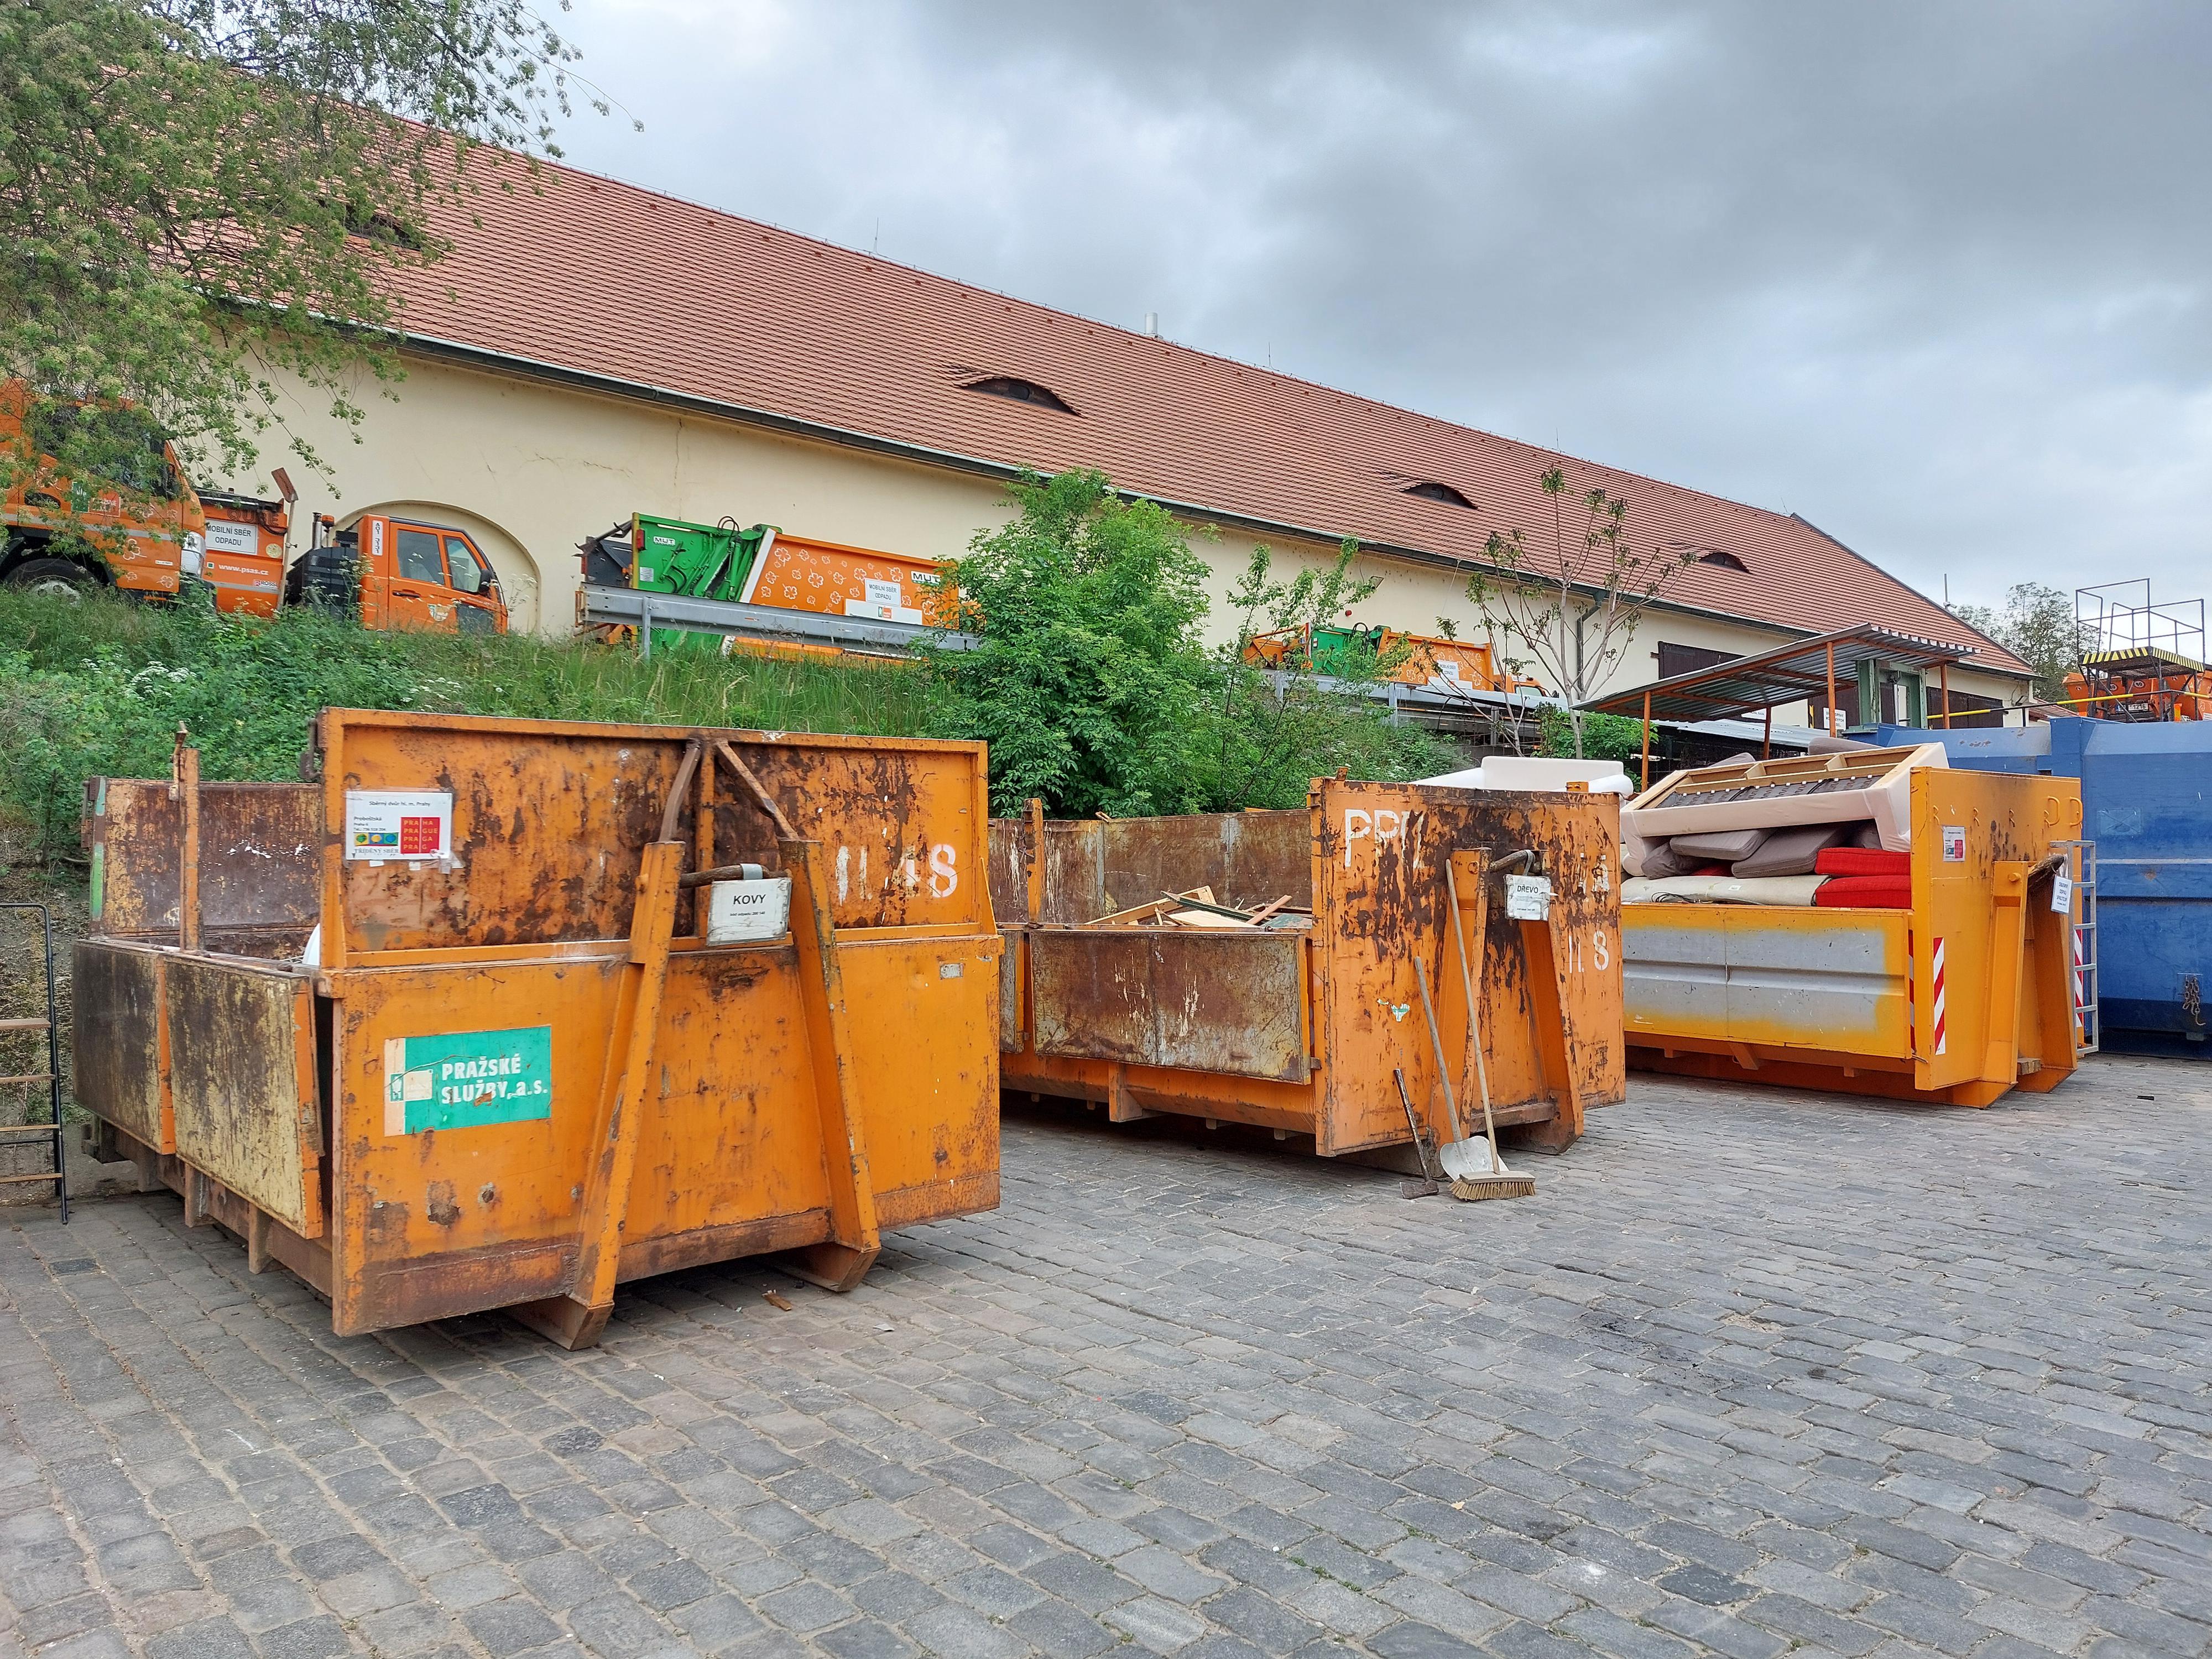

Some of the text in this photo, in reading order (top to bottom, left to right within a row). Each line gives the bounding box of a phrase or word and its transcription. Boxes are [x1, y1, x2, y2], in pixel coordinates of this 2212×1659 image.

[215, 536, 242, 546] ODPADU
[218, 564, 269, 576] www.psas.cz
[1517, 884, 1538, 894] DŘEVO
[733, 894, 766, 905] KOVY
[442, 1053, 521, 1081] PRAŽSKÉ
[515, 1080, 548, 1097] a.s.
